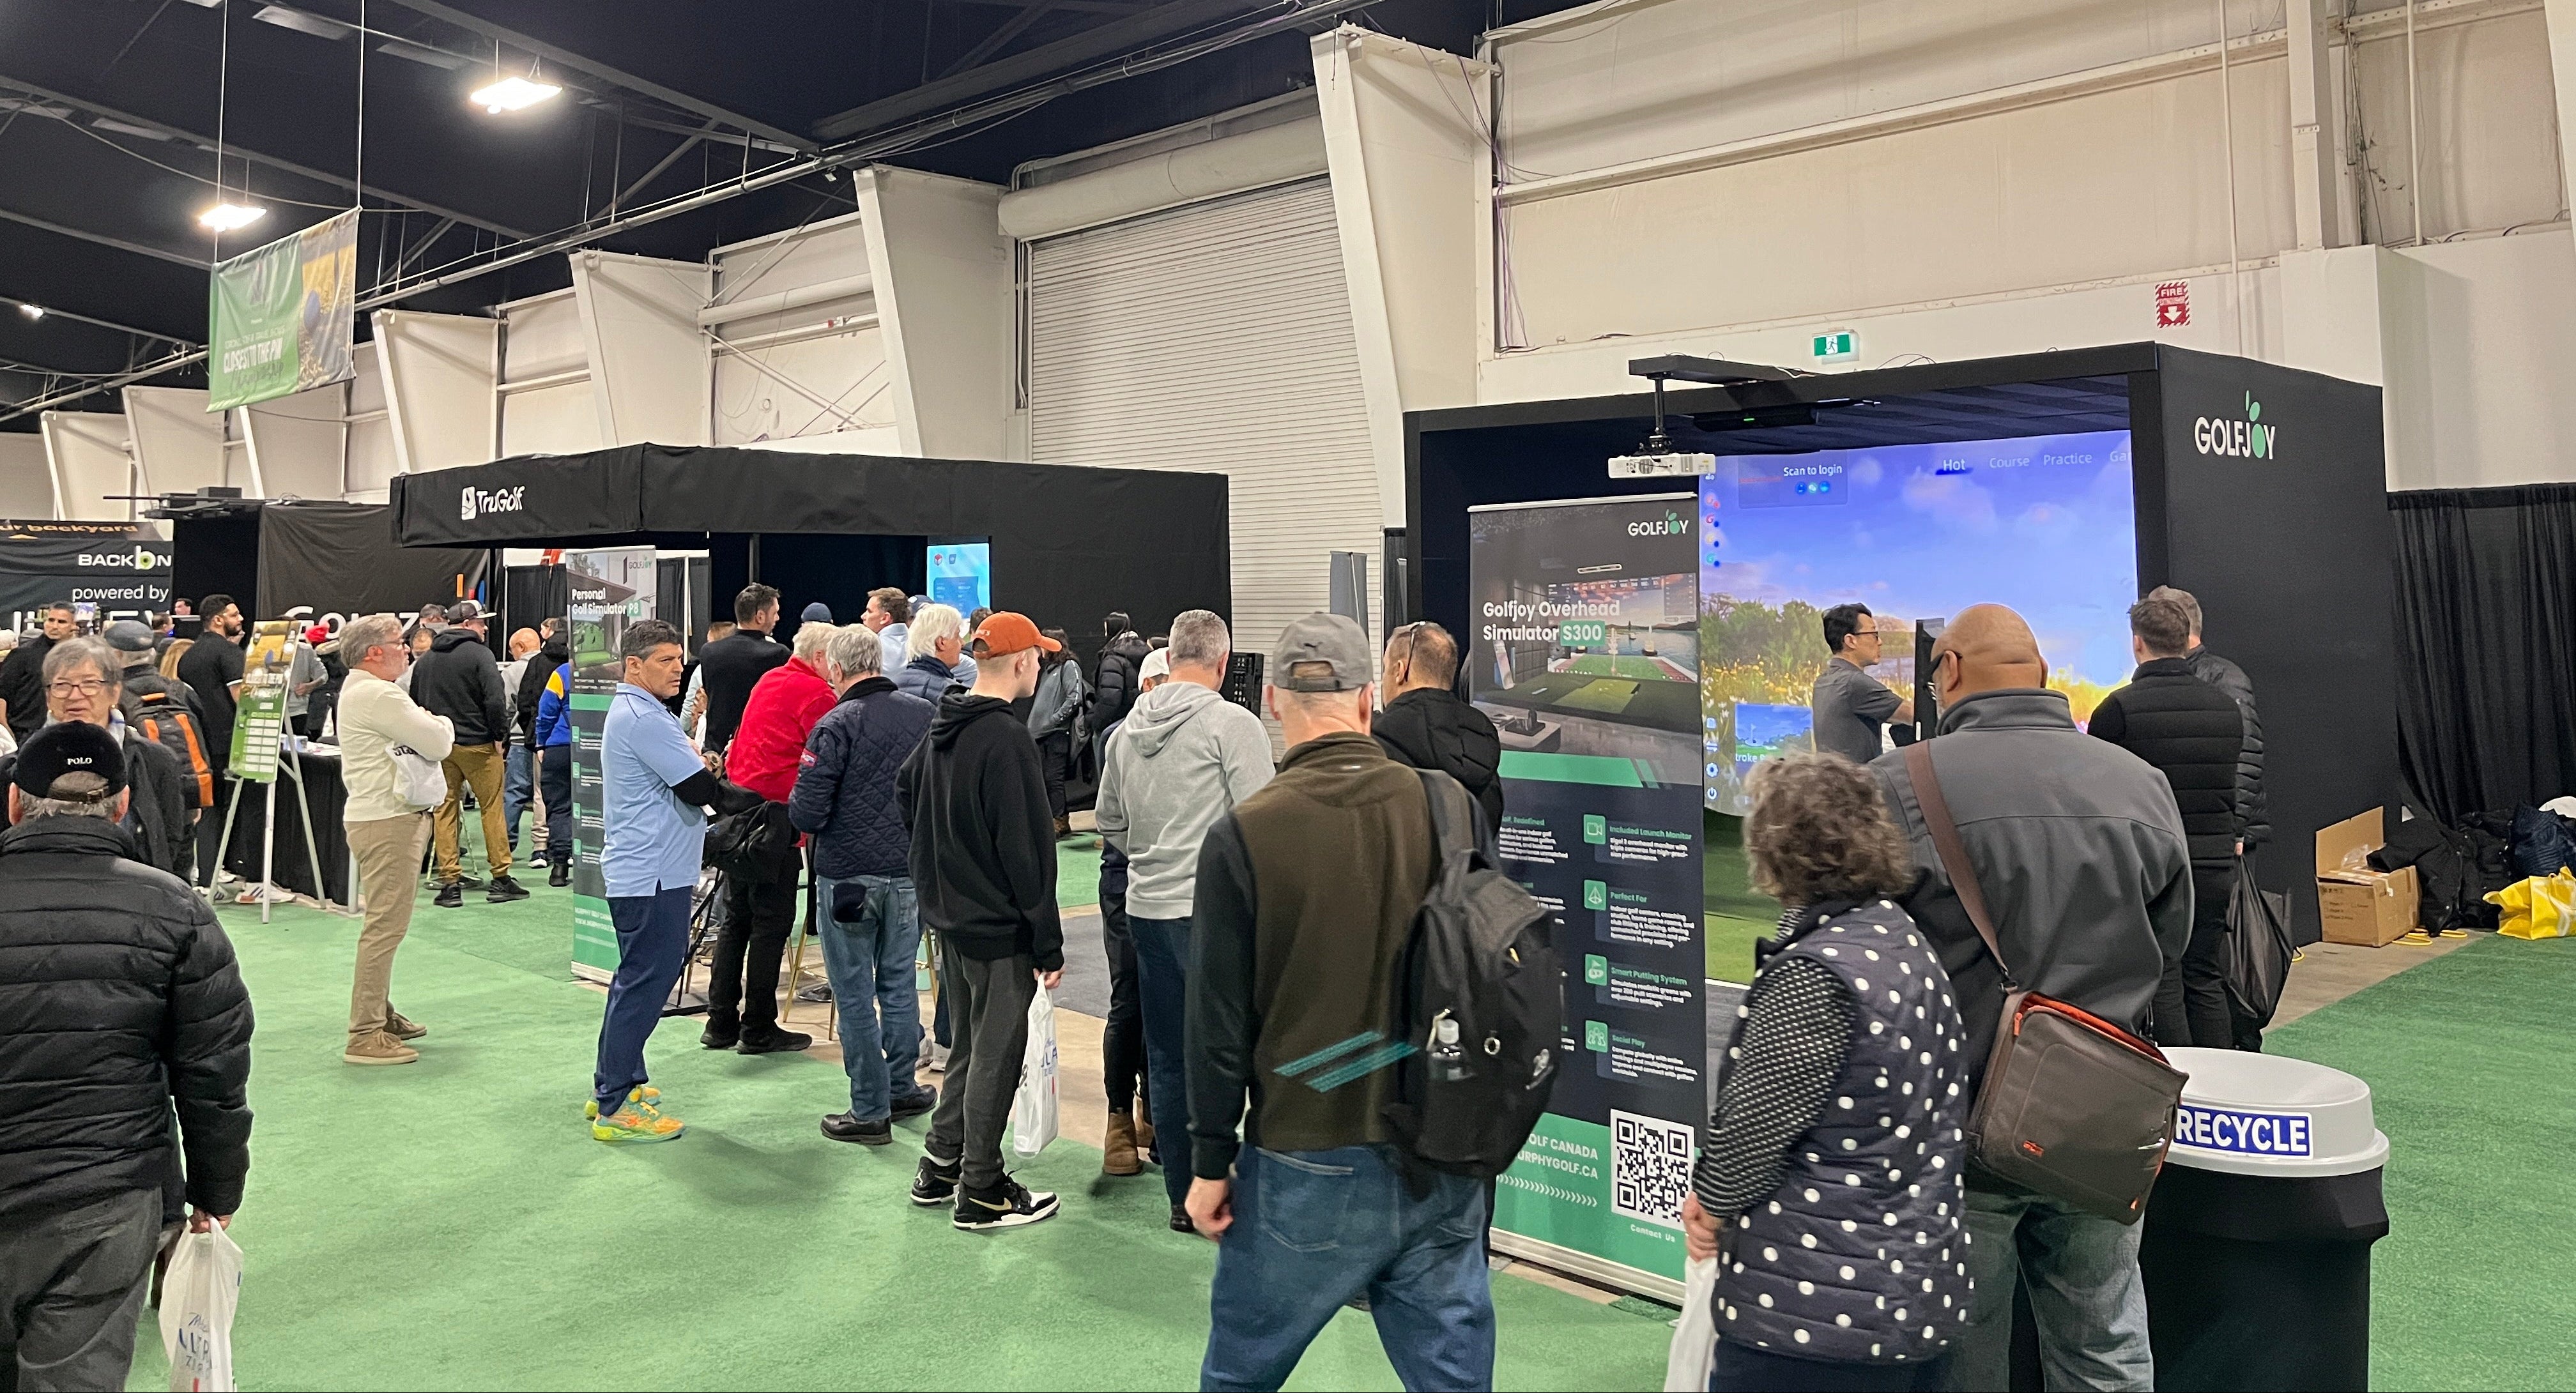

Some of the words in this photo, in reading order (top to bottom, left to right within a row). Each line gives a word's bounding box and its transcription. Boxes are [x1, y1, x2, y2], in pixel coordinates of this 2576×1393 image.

[2161, 287, 2184, 297] FIRE
[2195, 401, 2275, 460] GOLFJOY
[1783, 467, 1805, 476] Scan
[1807, 466, 1817, 475] to
[1818, 464, 1843, 476] login
[1943, 459, 1966, 471] Hot
[1989, 457, 2030, 468] Course
[2044, 453, 2093, 466] Practice
[2110, 451, 2131, 462] Ga
[476, 485, 525, 513] TruGolf
[27, 524, 139, 533] backyard
[1628, 514, 1689, 537] GOLFJOY
[72, 584, 144, 602] powered
[150, 584, 169, 602] by
[572, 588, 606, 600] Personal
[588, 602, 627, 614] Simulator
[629, 602, 640, 614] P8
[1483, 600, 1536, 622] Golfjoy
[1538, 600, 1620, 618] Overhead
[1483, 624, 1560, 641] Simulator
[1563, 624, 1602, 641] S300
[1735, 753, 1758, 762] troke
[1610, 892, 1635, 902] Perfect
[1636, 894, 1647, 903] For
[1611, 967, 1632, 978] Smart
[1633, 970, 1660, 984] Putting
[1660, 975, 1687, 986] System
[2175, 1108, 2308, 1152] RECYCLE
[1528, 1133, 1549, 1147] OLF
[1550, 1138, 1598, 1160] CANADA
[1517, 1150, 1598, 1180] URPHYGOLF.CA
[1630, 1224, 1662, 1239] Contact
[1665, 1233, 1675, 1243] Us
